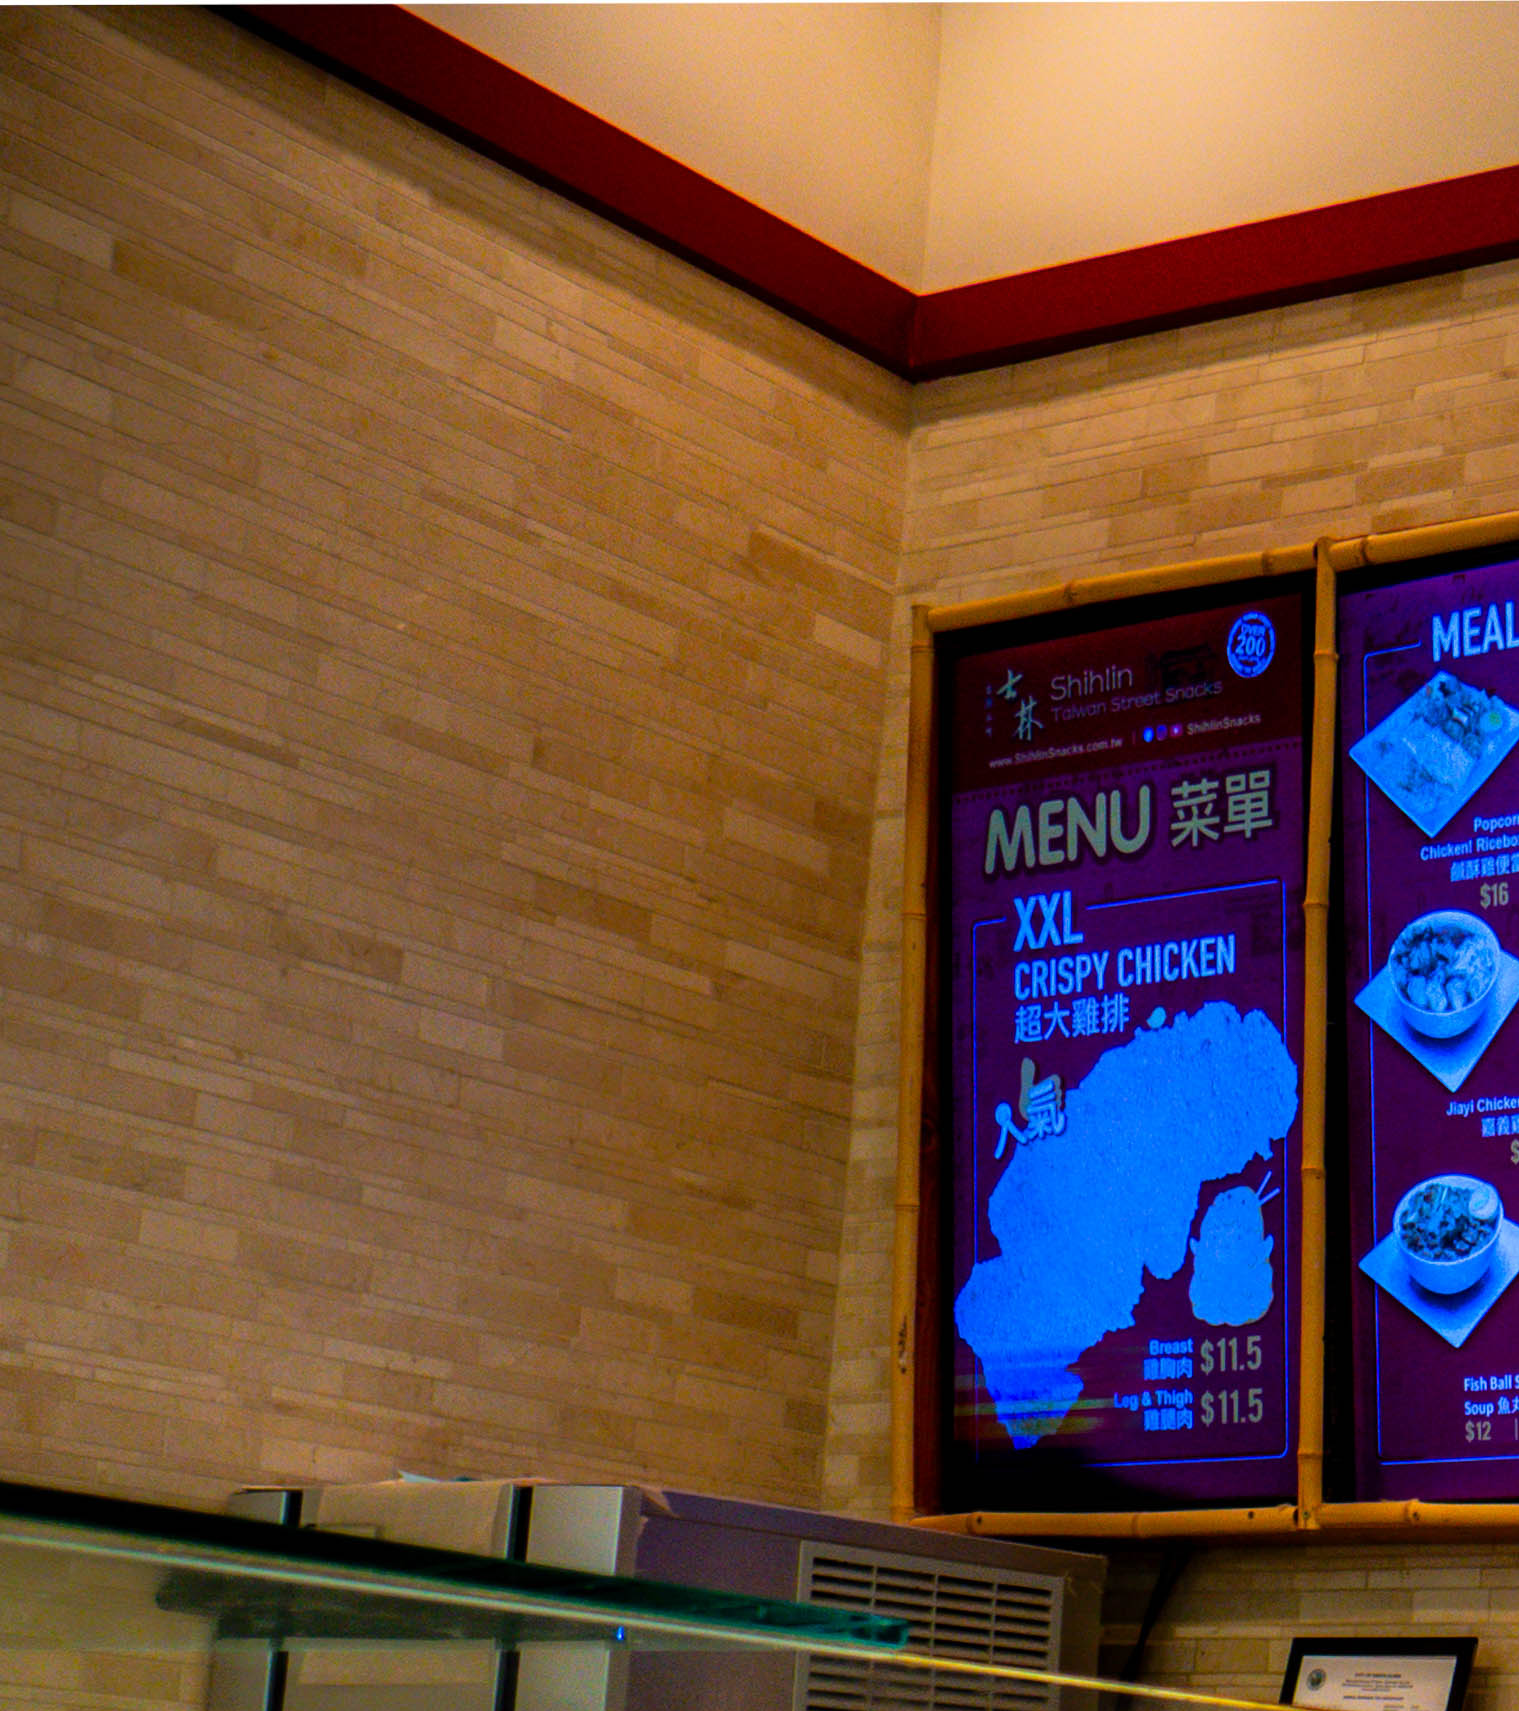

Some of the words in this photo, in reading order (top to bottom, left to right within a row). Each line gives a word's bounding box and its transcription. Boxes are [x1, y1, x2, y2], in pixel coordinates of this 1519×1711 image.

[1236, 635, 1266, 657] 200
[1050, 664, 1133, 700] Shihlin
[1050, 703, 1106, 722] Taiwan
[1112, 694, 1160, 712] Street
[1166, 680, 1222, 703] Snacks
[1186, 714, 1261, 735] ShihlinSnacks
[984, 784, 1150, 875] MENU
[1170, 769, 1273, 847] 菜單
[1480, 883, 1509, 910] $16
[1013, 891, 1083, 952] XXL
[1014, 950, 1109, 1000] CRISPY
[1118, 933, 1235, 988] CHICKEN
[1013, 995, 1130, 1044] 超大雞排
[1150, 1337, 1194, 1356] Breast
[1200, 1335, 1262, 1376] $11.5
[1464, 1376, 1487, 1391] Fish
[1490, 1375, 1512, 1390] Ball
[1155, 1388, 1194, 1409] Thigh
[1201, 1388, 1264, 1428] $11.5
[1464, 1401, 1494, 1417] Soup
[1465, 1421, 1491, 1443] $12
